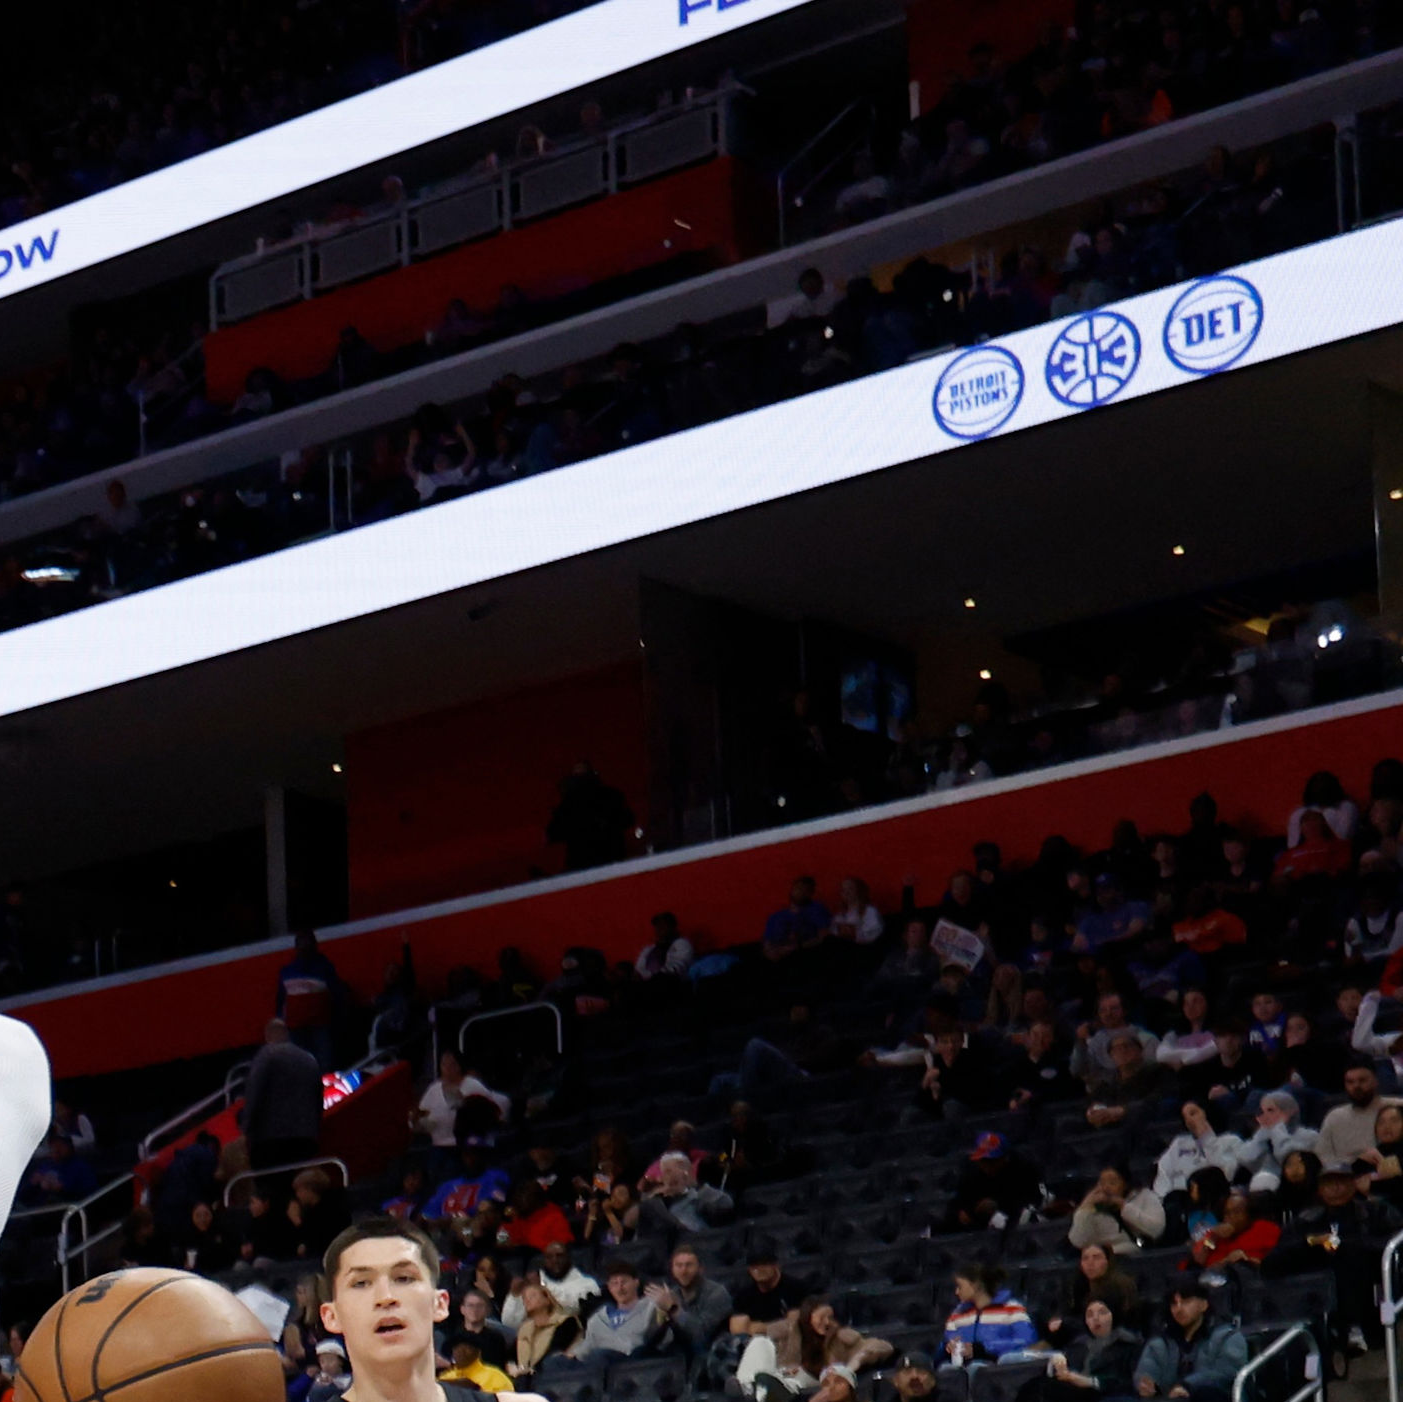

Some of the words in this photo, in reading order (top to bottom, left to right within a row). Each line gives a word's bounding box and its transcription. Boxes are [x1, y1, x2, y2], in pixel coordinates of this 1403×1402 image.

[1179, 301, 1245, 348] DET
[949, 370, 1007, 397] DETROIT
[949, 388, 1009, 415] PISTONS
